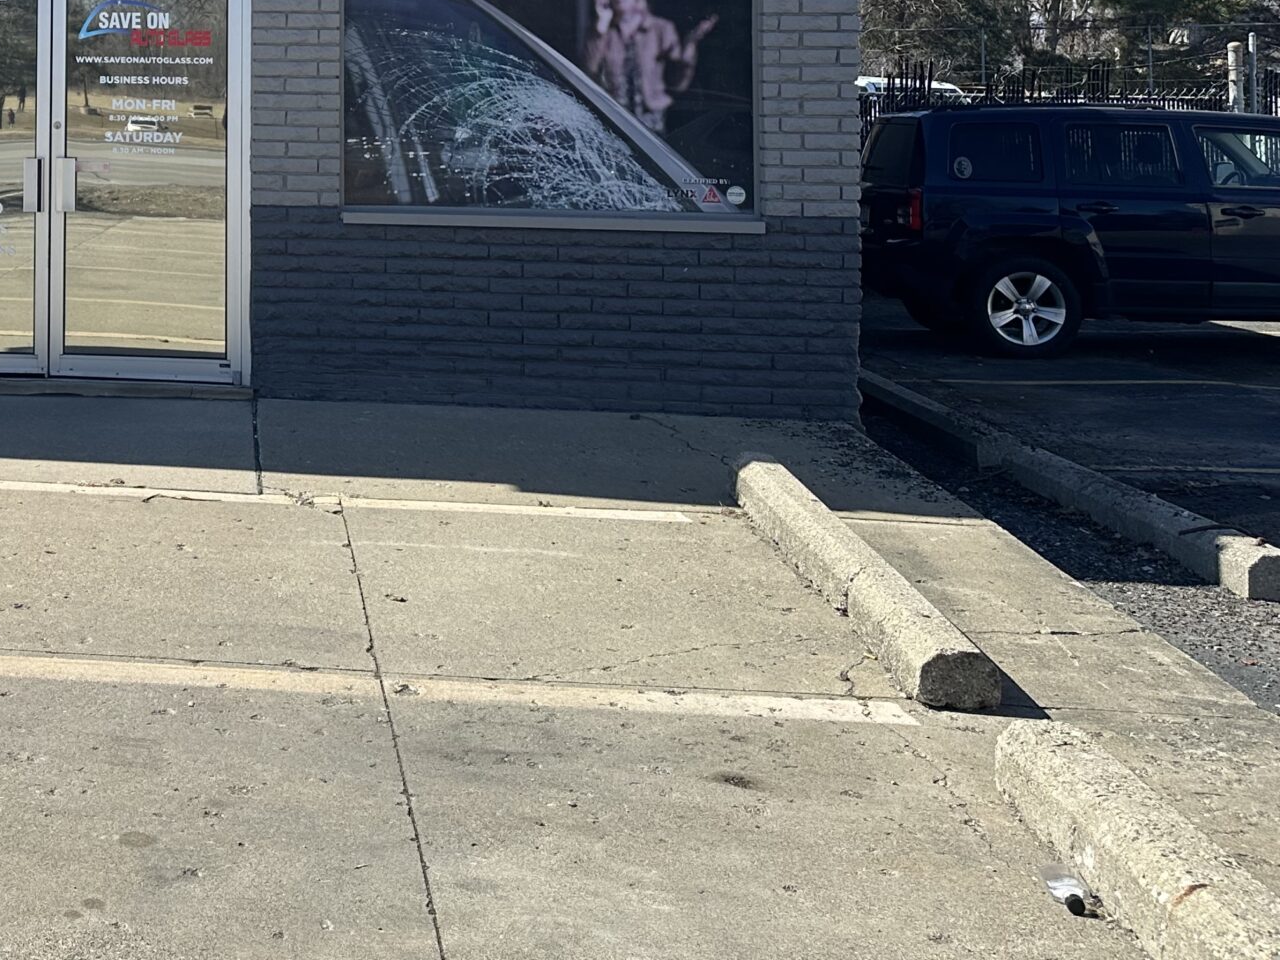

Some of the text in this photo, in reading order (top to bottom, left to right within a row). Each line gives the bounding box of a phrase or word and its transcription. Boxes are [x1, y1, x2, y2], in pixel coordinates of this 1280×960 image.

[98, 11, 170, 30] SAVE ON
[75, 56, 213, 65] WWW.SAVEONAUTOGLASS.COM
[99, 75, 189, 85] BUSINESS HOURS
[111, 99, 176, 111] MON-FRI
[104, 131, 183, 144] SATURDAY
[667, 189, 697, 198] LYNX
